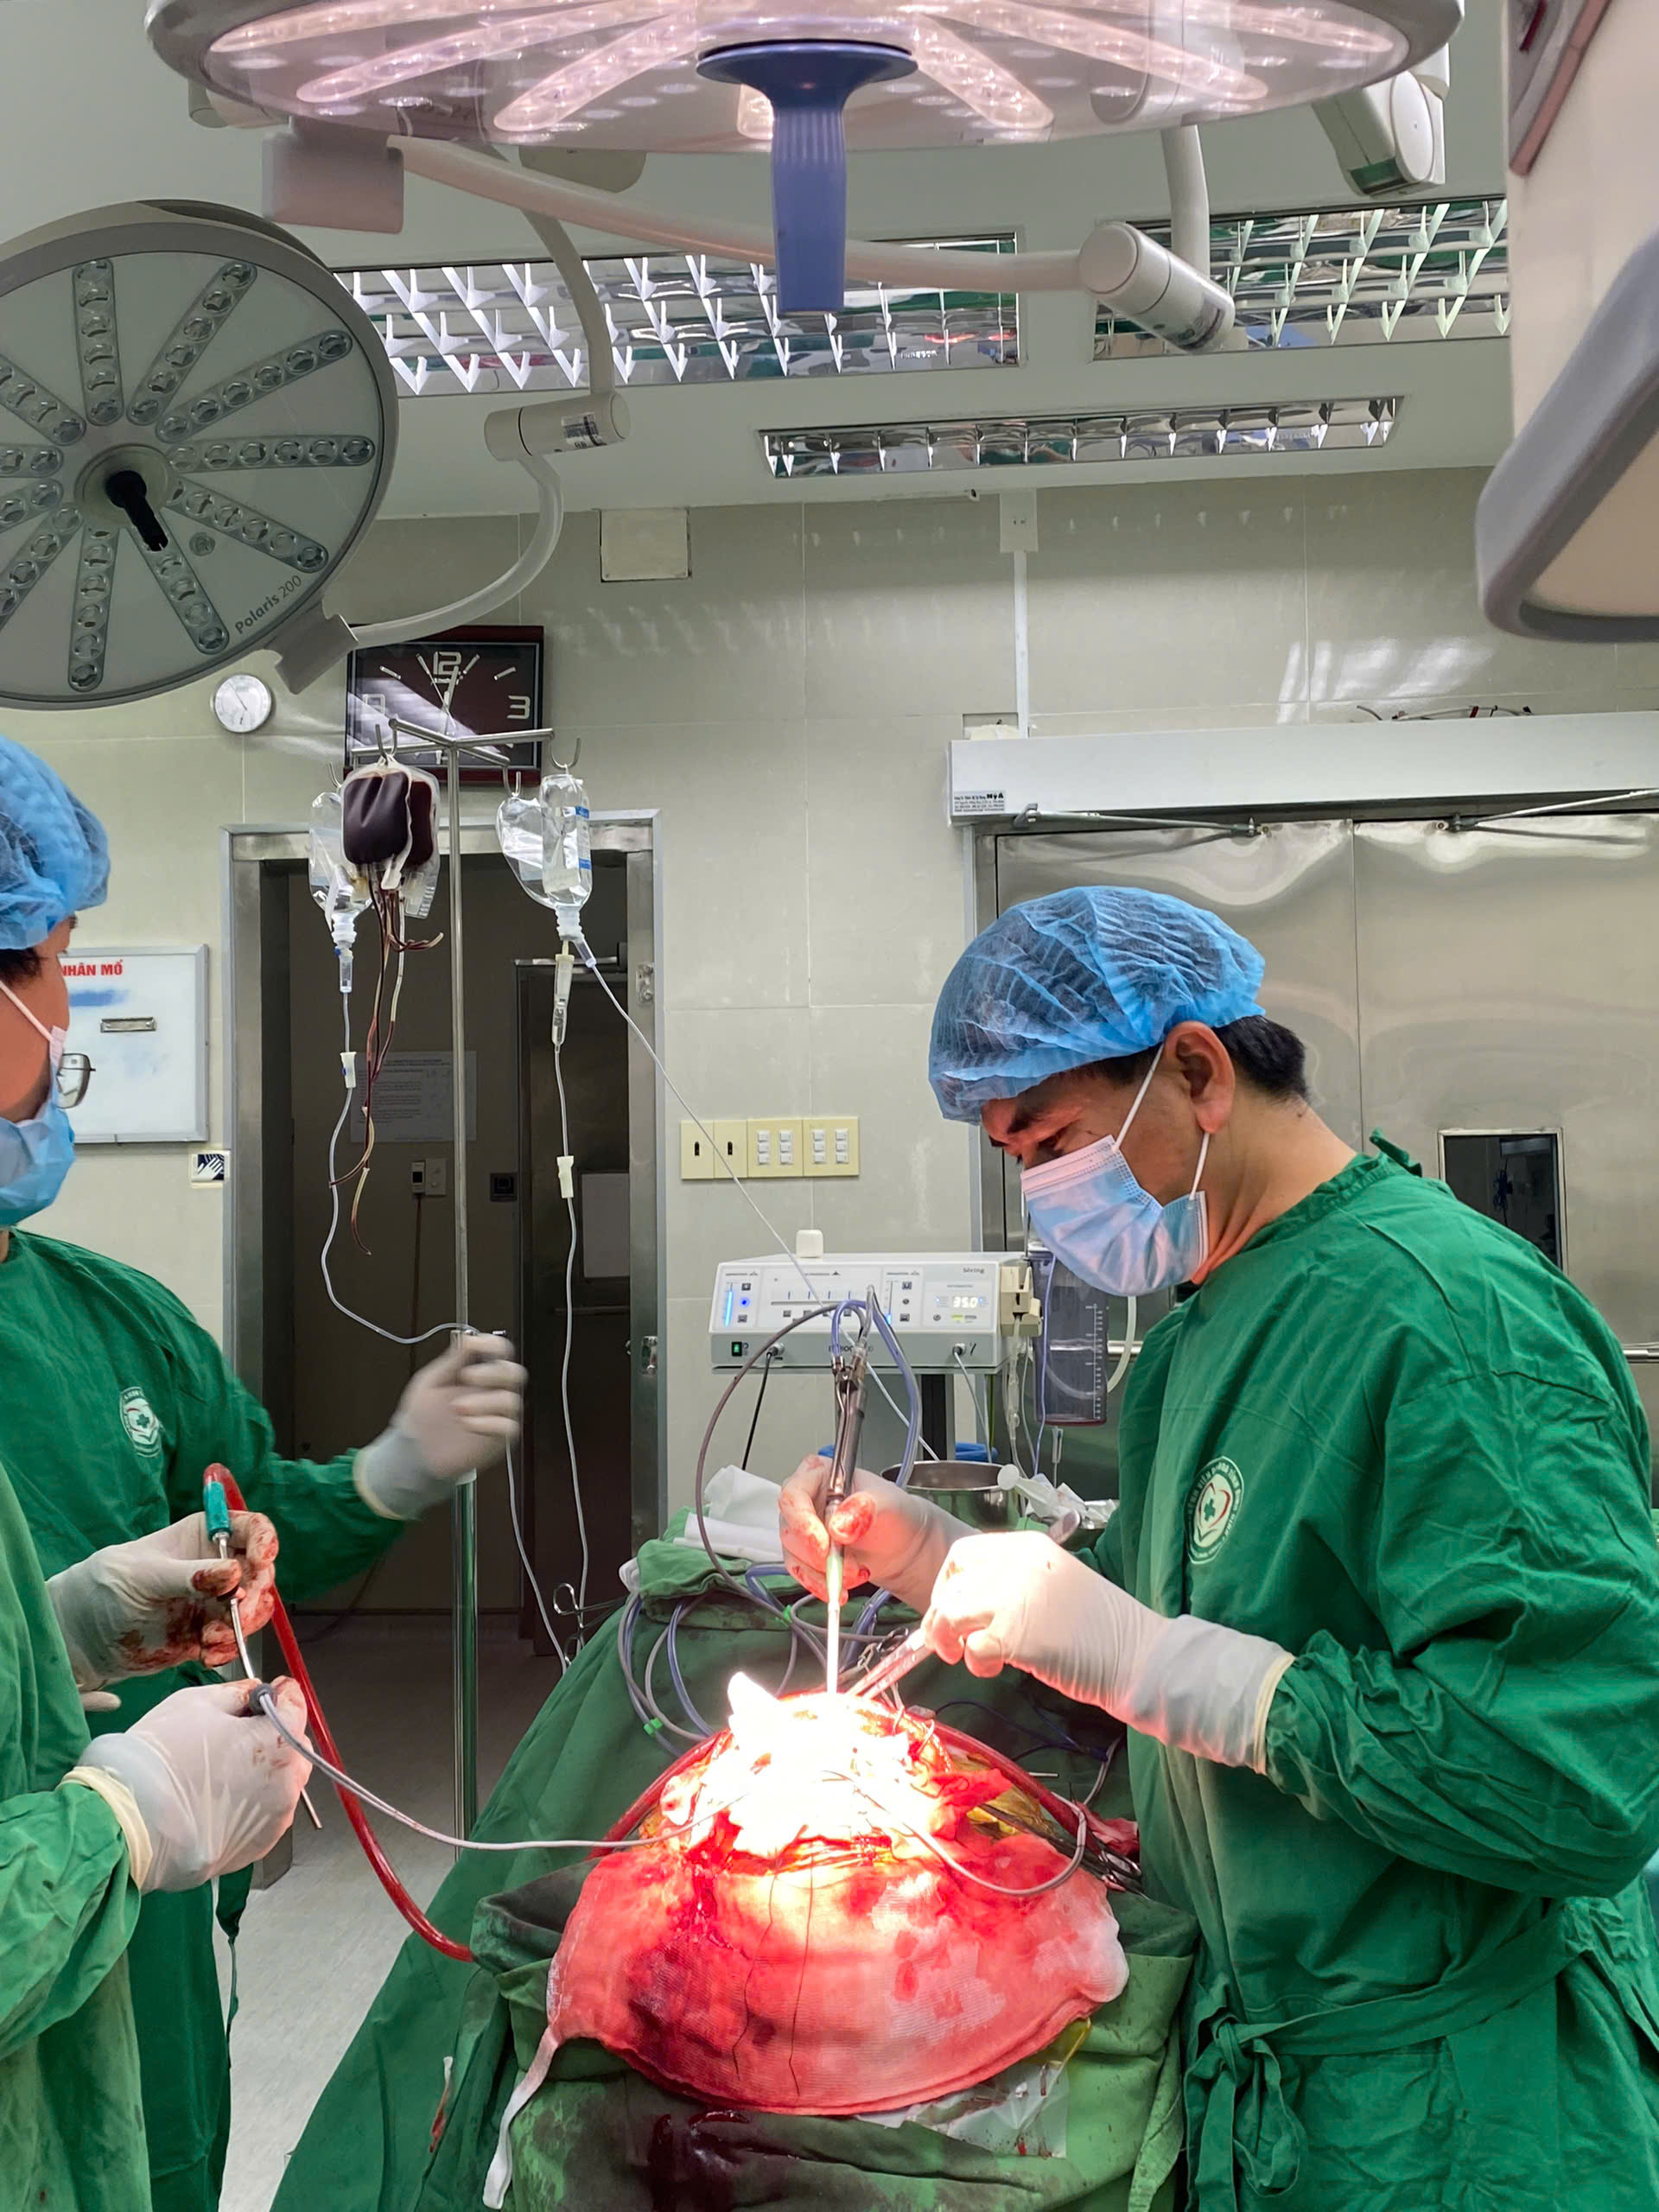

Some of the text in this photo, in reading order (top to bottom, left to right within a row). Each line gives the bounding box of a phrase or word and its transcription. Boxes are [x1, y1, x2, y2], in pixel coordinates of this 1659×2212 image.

[235, 575, 302, 634] Polaris 200
[433, 652, 461, 675] 12
[507, 695, 531, 719] 3
